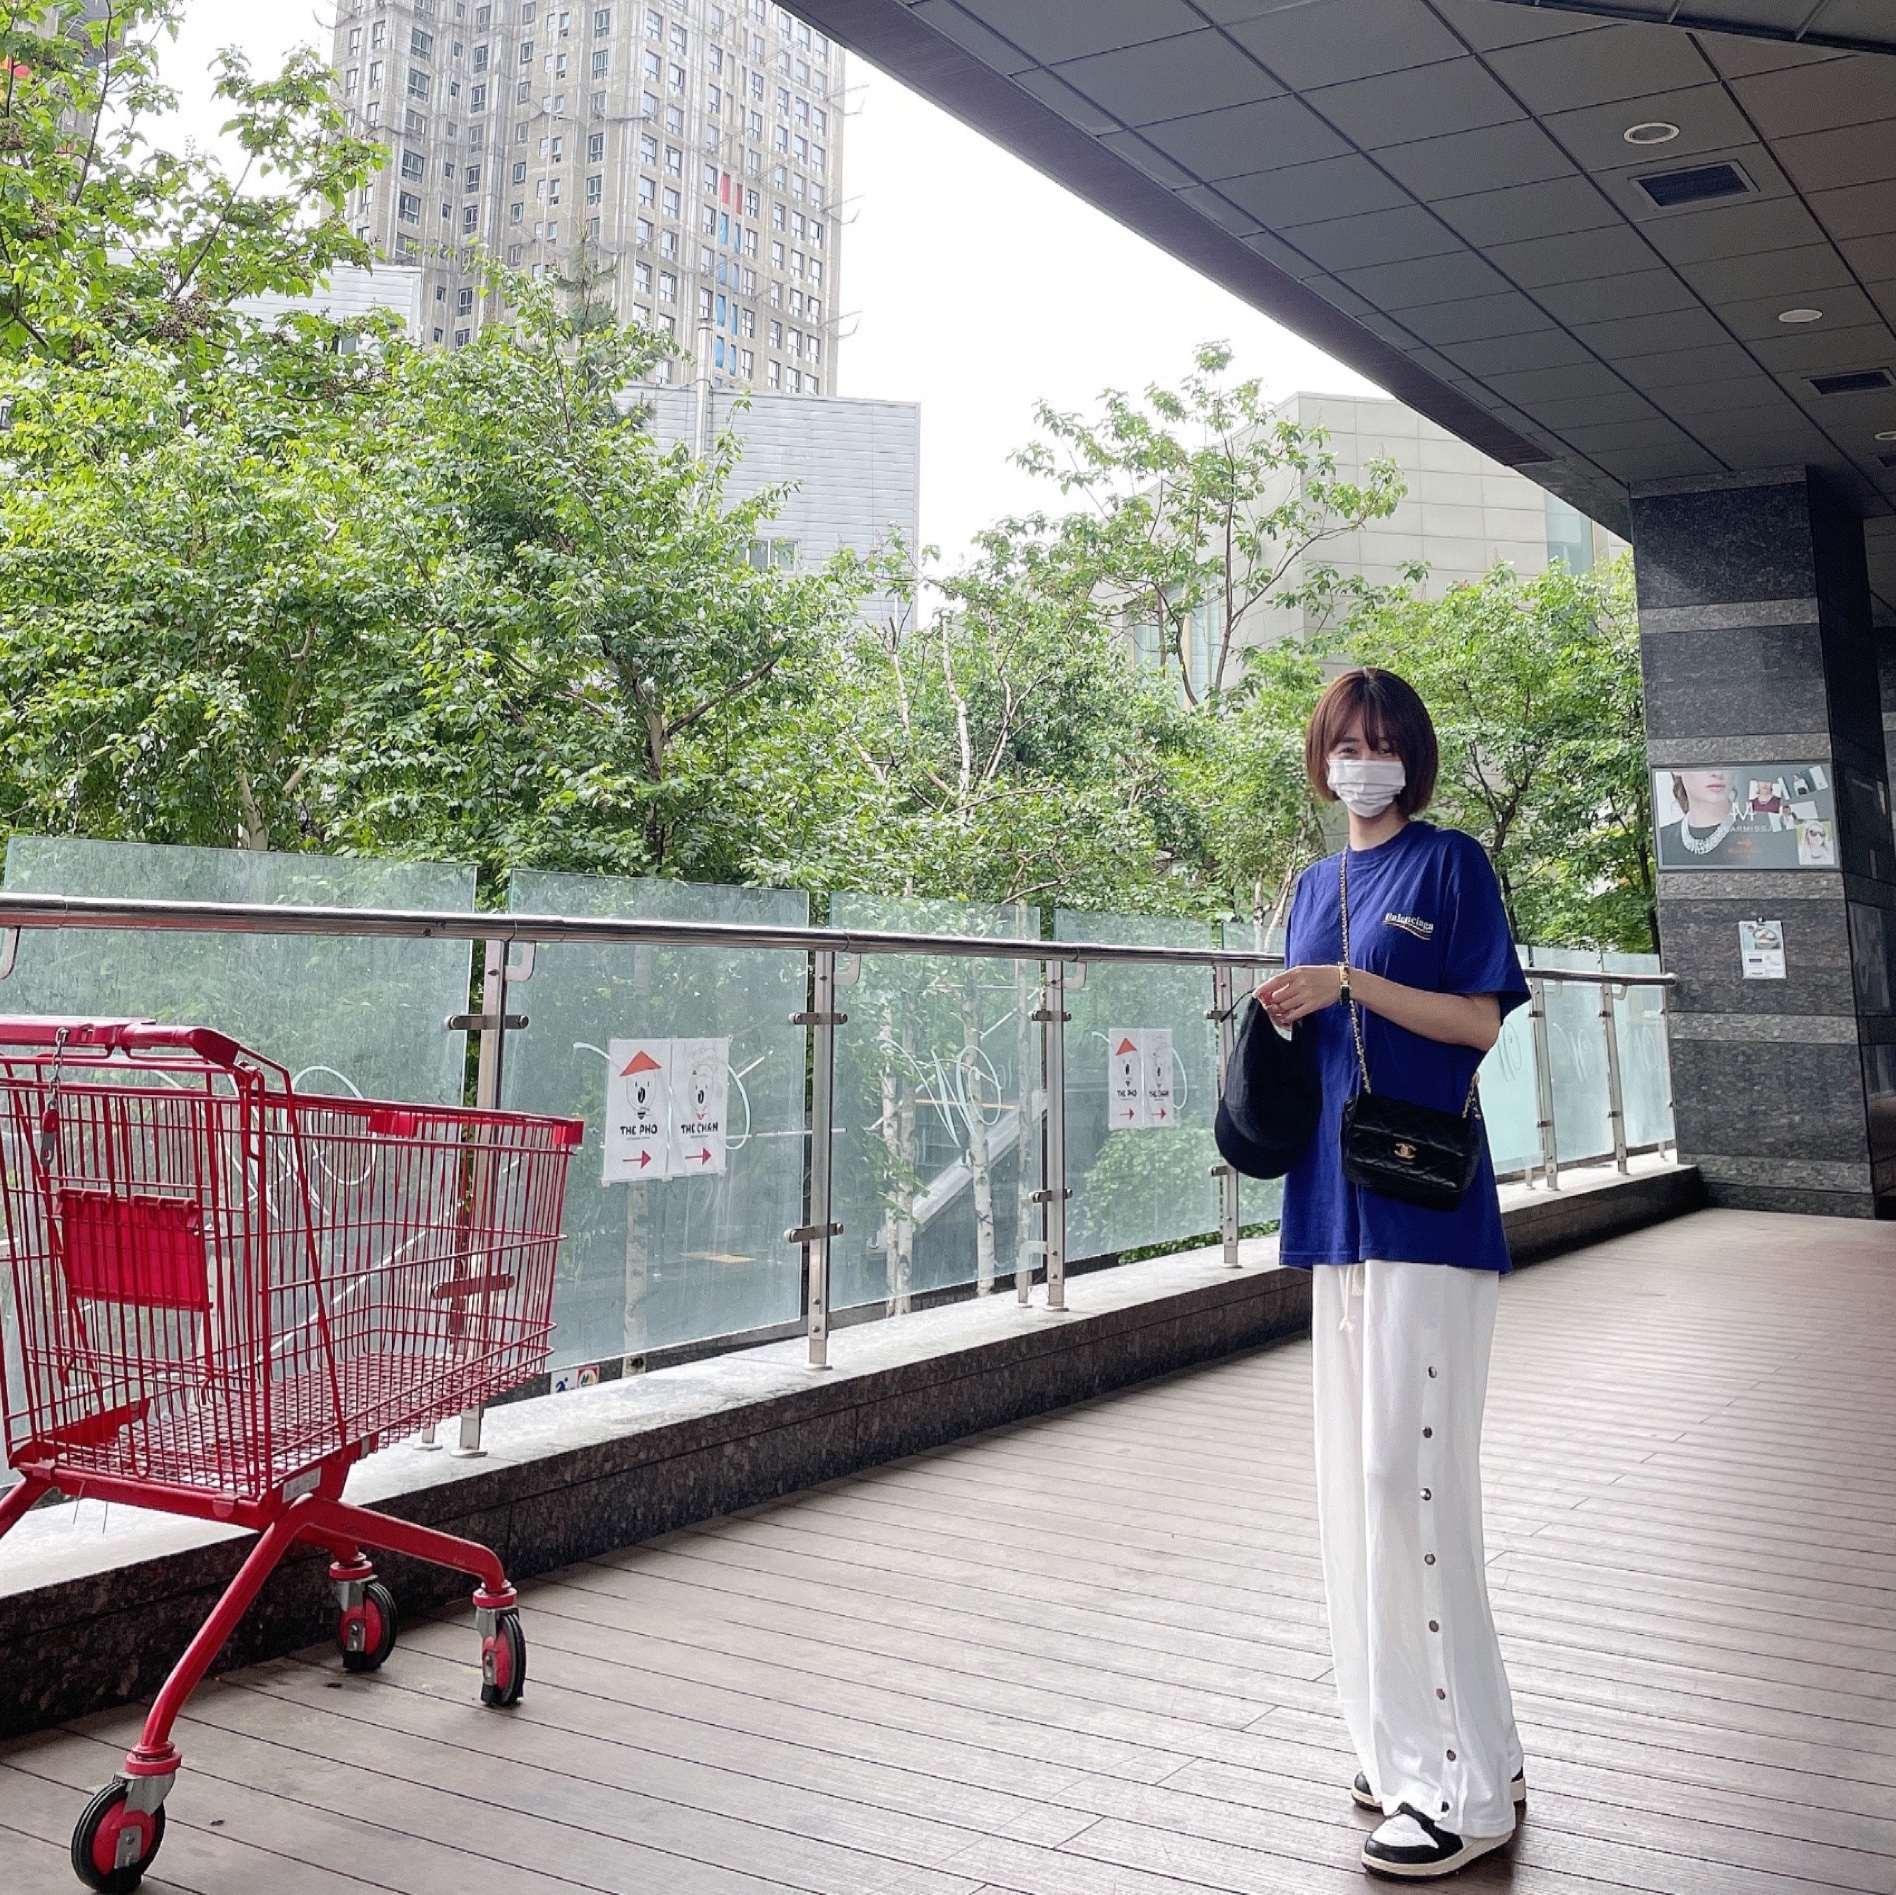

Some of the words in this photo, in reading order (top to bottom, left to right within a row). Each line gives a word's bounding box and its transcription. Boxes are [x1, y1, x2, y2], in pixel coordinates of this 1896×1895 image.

[620, 1126, 637, 1135] THE
[639, 1123, 658, 1134] PHO
[681, 1124, 696, 1134] THE
